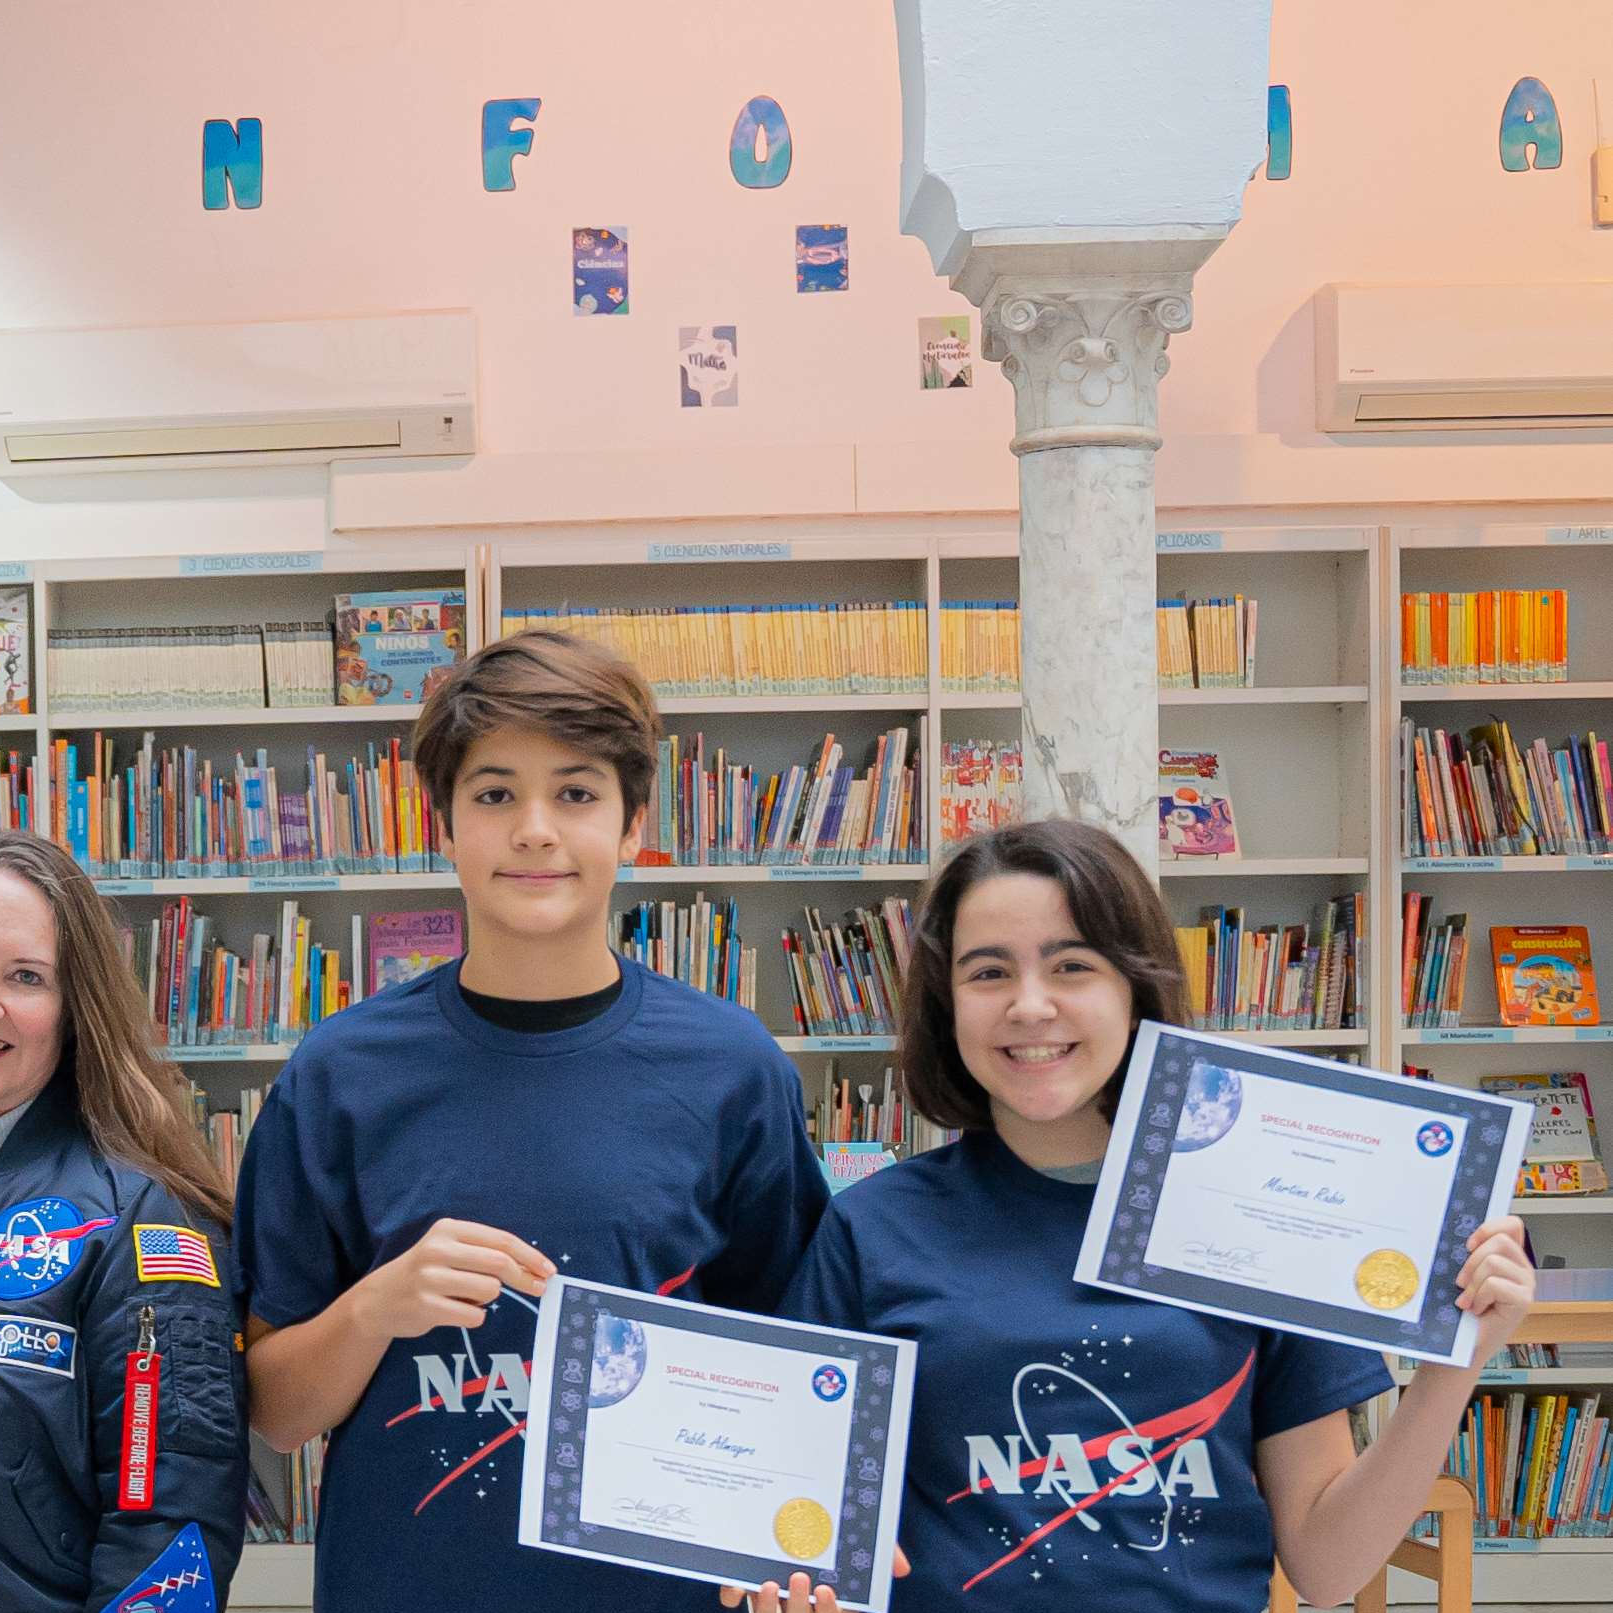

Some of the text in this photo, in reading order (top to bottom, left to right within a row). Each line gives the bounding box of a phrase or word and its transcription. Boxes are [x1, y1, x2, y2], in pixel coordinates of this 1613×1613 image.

[577, 259, 624, 269] Ciencias
[664, 544, 717, 557] CIENCIAS
[720, 543, 781, 556] NATURALES
[203, 557, 254, 571] CIENCIAS
[258, 555, 310, 569] SOCIALES
[380, 656, 442, 667] CONTINENTES
[1531, 1092, 1579, 1106] ÉRTETE
[1261, 1114, 1304, 1130] SPECIAL
[1306, 1123, 1381, 1146] RECOGNITION
[412, 1352, 533, 1414] NA
[666, 1365, 707, 1381] SPECIAL
[709, 1374, 780, 1393] RECOGNITION
[127, 1383, 152, 1503] REMOVE BEFORE FLIGHT
[675, 1429, 706, 1447] Pablo
[964, 1433, 1220, 1498] NASA
